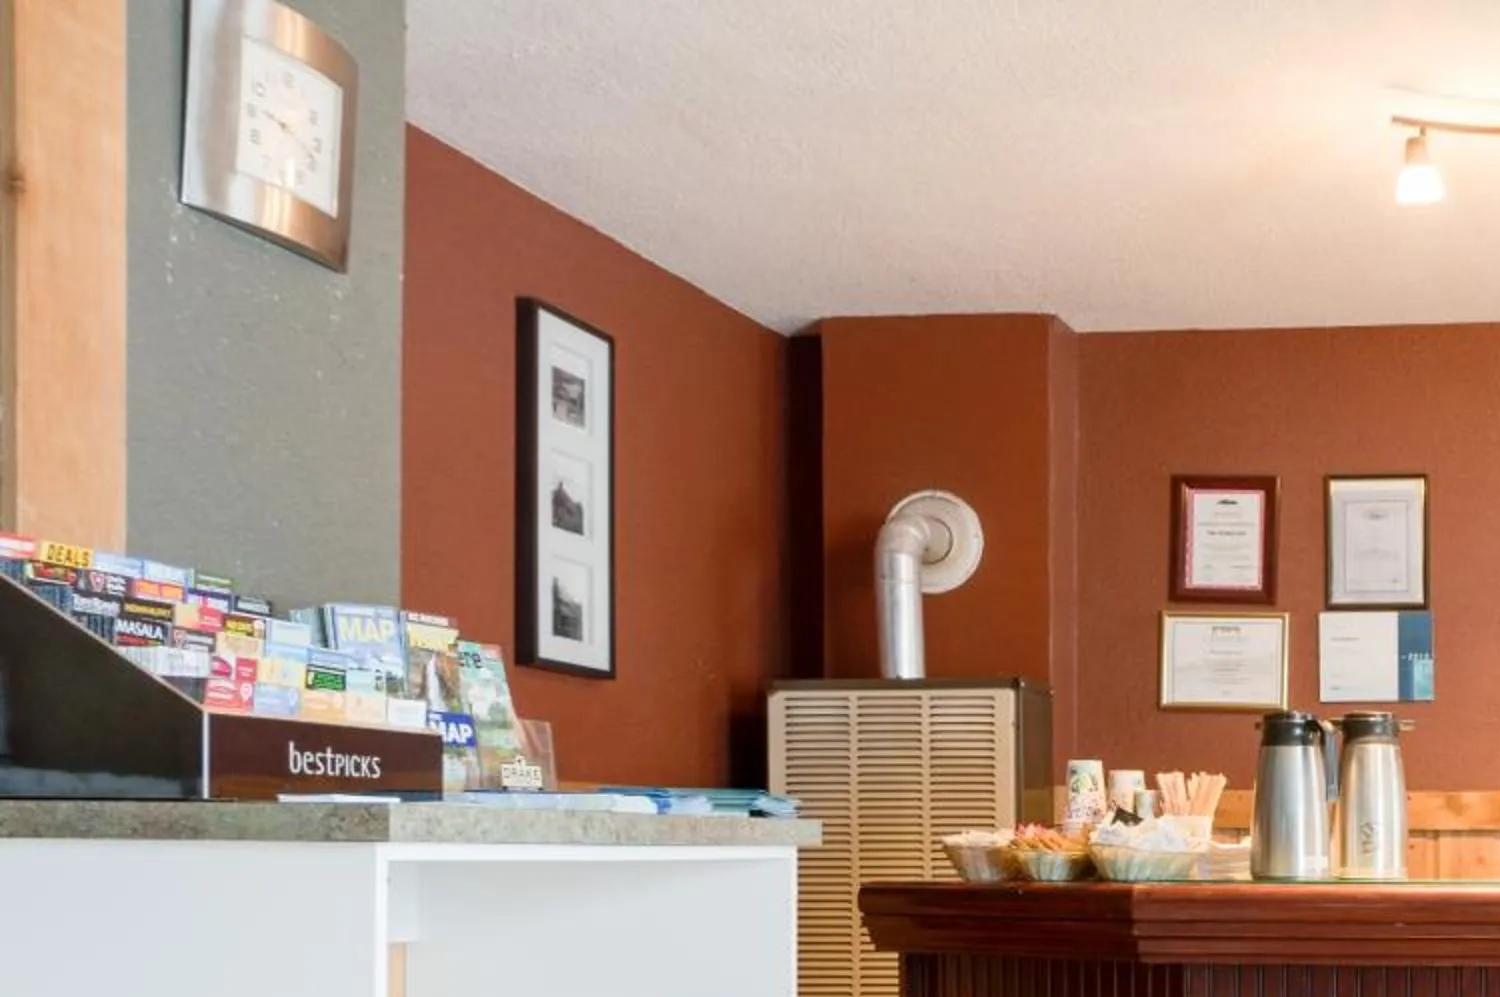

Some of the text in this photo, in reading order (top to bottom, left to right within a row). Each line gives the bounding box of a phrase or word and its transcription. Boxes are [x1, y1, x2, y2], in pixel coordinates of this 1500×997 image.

[47, 543, 90, 567] DEALS
[115, 617, 164, 640] MASALA
[339, 615, 396, 643] MAP
[288, 740, 382, 779] bestPICKS
